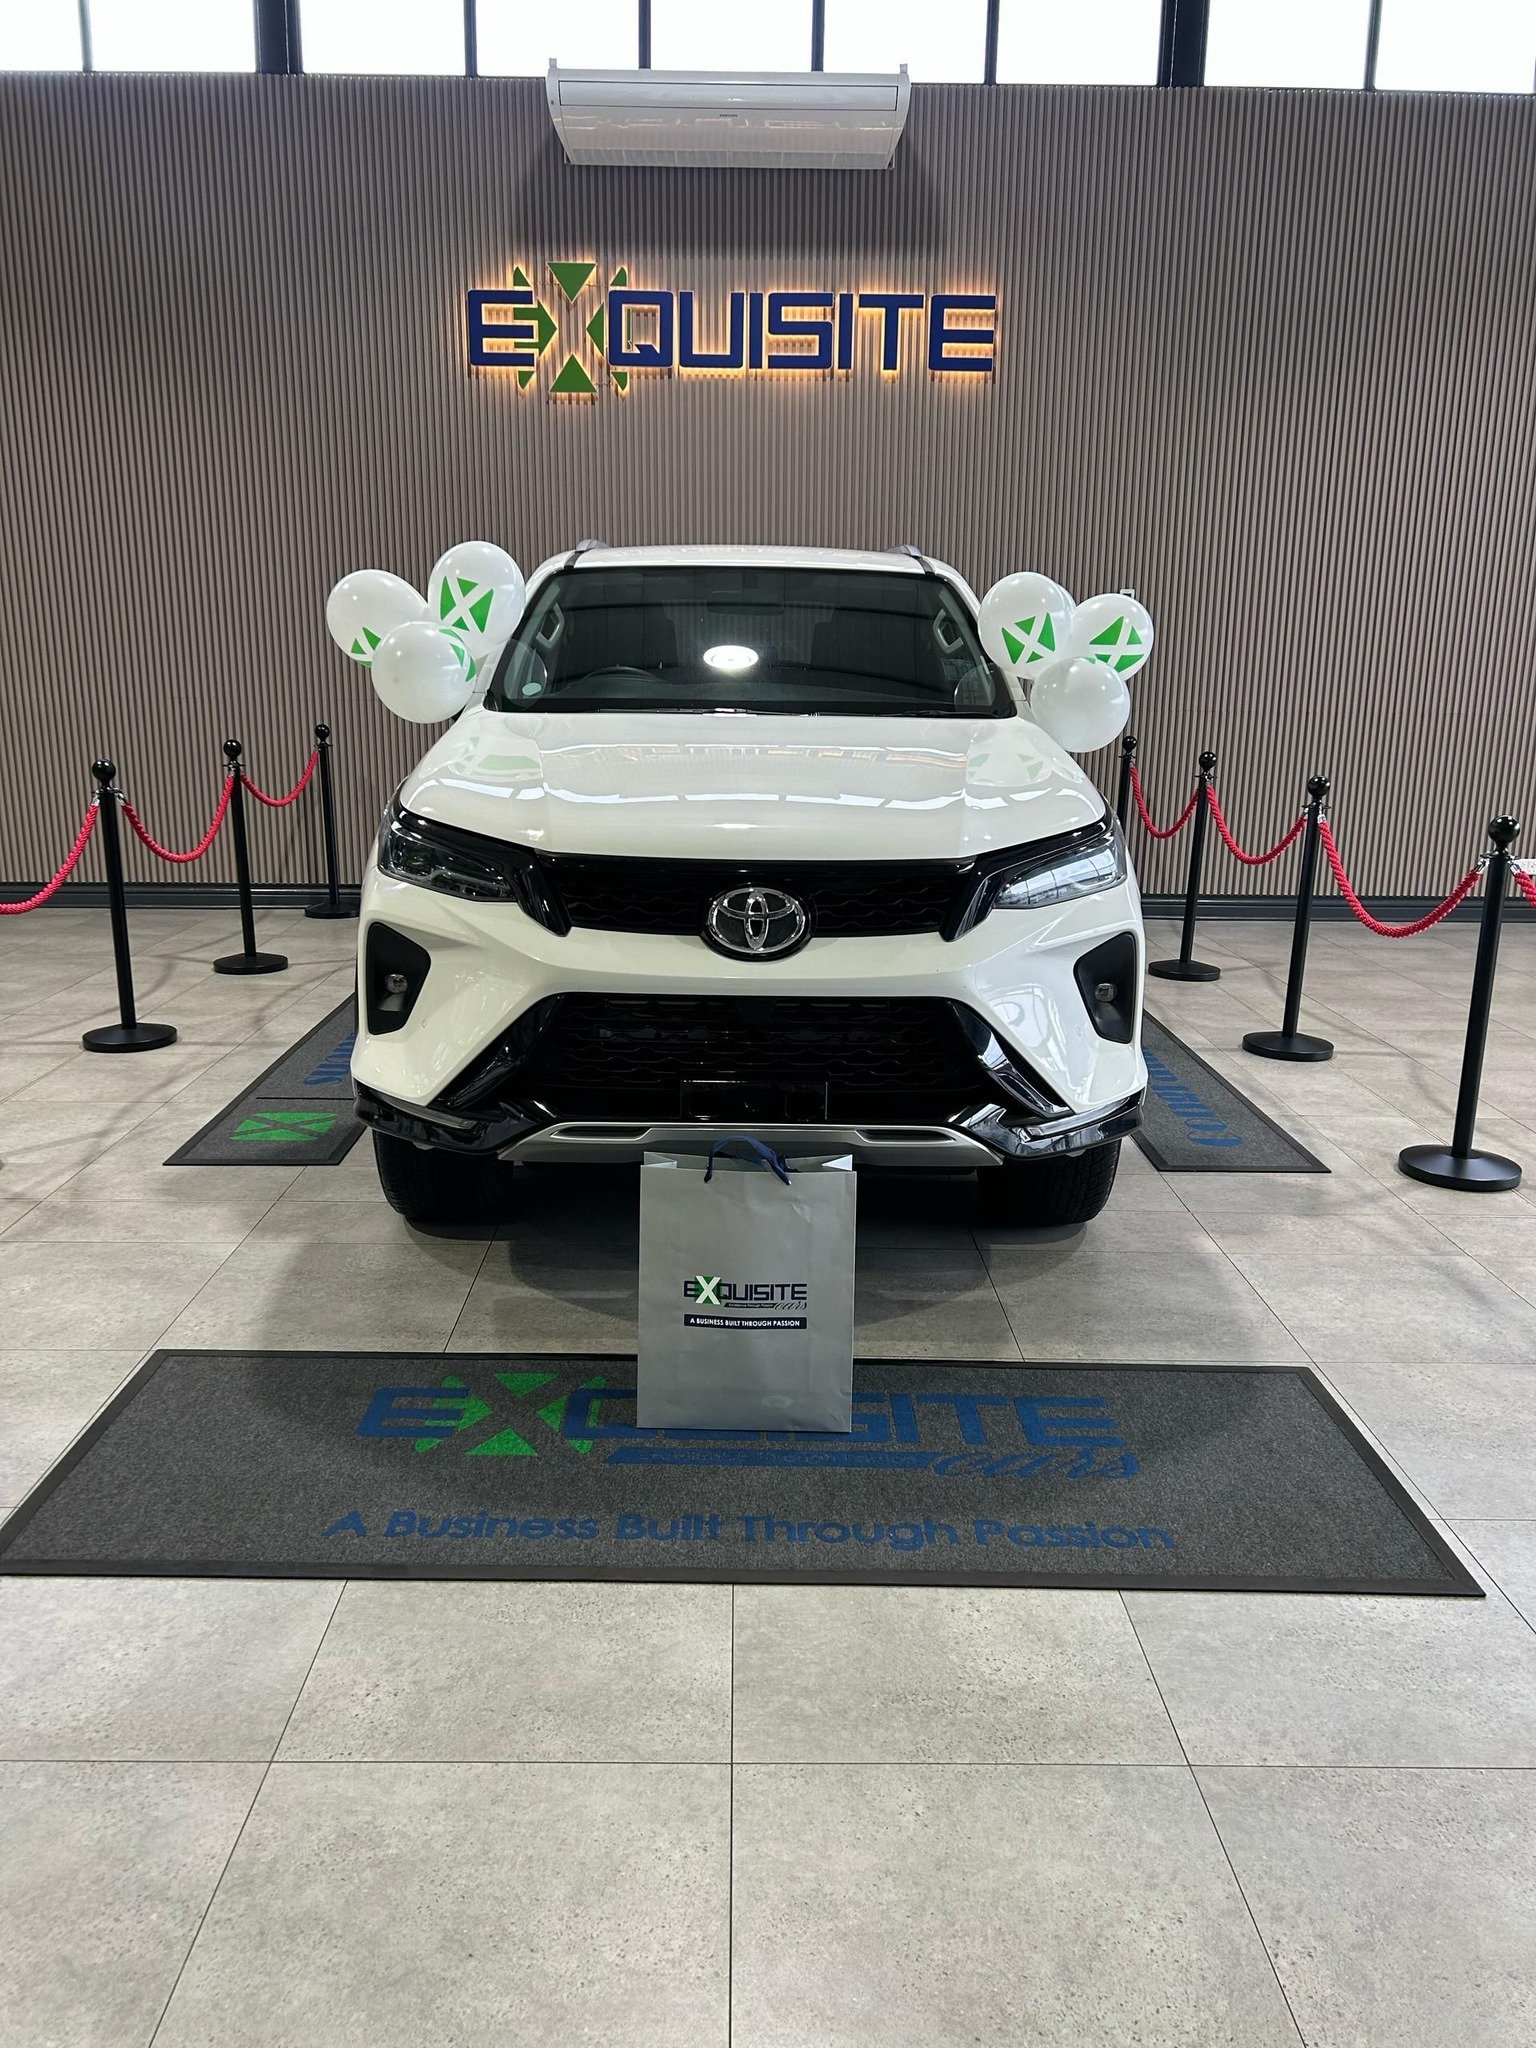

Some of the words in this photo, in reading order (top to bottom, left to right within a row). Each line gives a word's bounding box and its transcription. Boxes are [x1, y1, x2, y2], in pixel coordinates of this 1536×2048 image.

[467, 261, 998, 394] EXQUISITE
[683, 1275, 808, 1305] EXQUISITE
[696, 1318, 724, 1327] BUSINESS
[725, 1319, 741, 1327] BUILT
[741, 1319, 772, 1327] THROUGH
[773, 1318, 800, 1327] PASSION
[357, 1373, 1126, 1457] EXQITE
[322, 1510, 367, 1538] A
[384, 1508, 598, 1541] Business
[617, 1511, 721, 1542] Built
[738, 1513, 959, 1552] Through
[974, 1519, 1176, 1550] Passion
